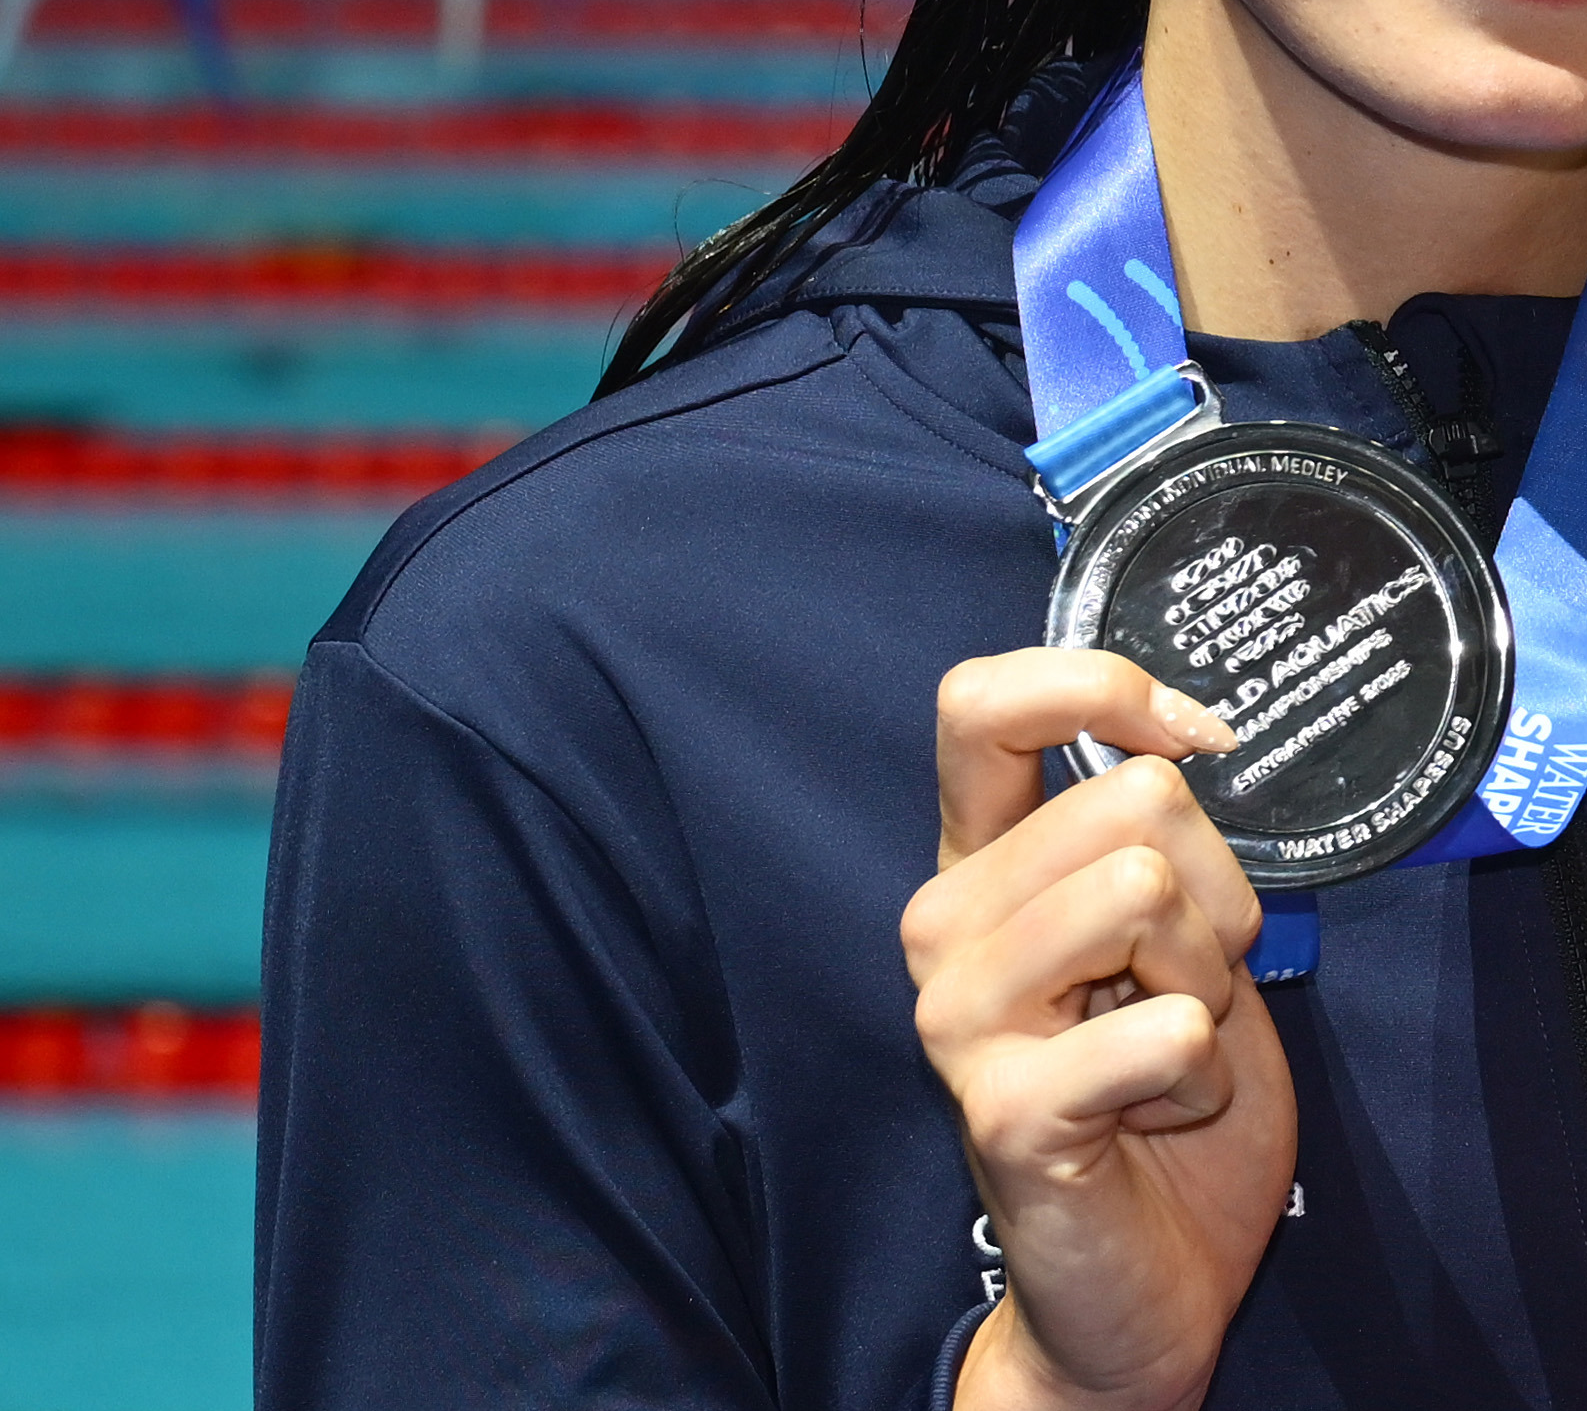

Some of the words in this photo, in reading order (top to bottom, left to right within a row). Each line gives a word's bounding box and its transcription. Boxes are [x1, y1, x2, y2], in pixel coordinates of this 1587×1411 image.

[1270, 455, 1348, 486] MEDLEY
[1272, 564, 1432, 688] AQUATICS
[1277, 822, 1371, 860] WATER
[1371, 749, 1454, 833] SHAPES
[1442, 716, 1472, 751] US
[1482, 707, 1553, 828] SHAP
